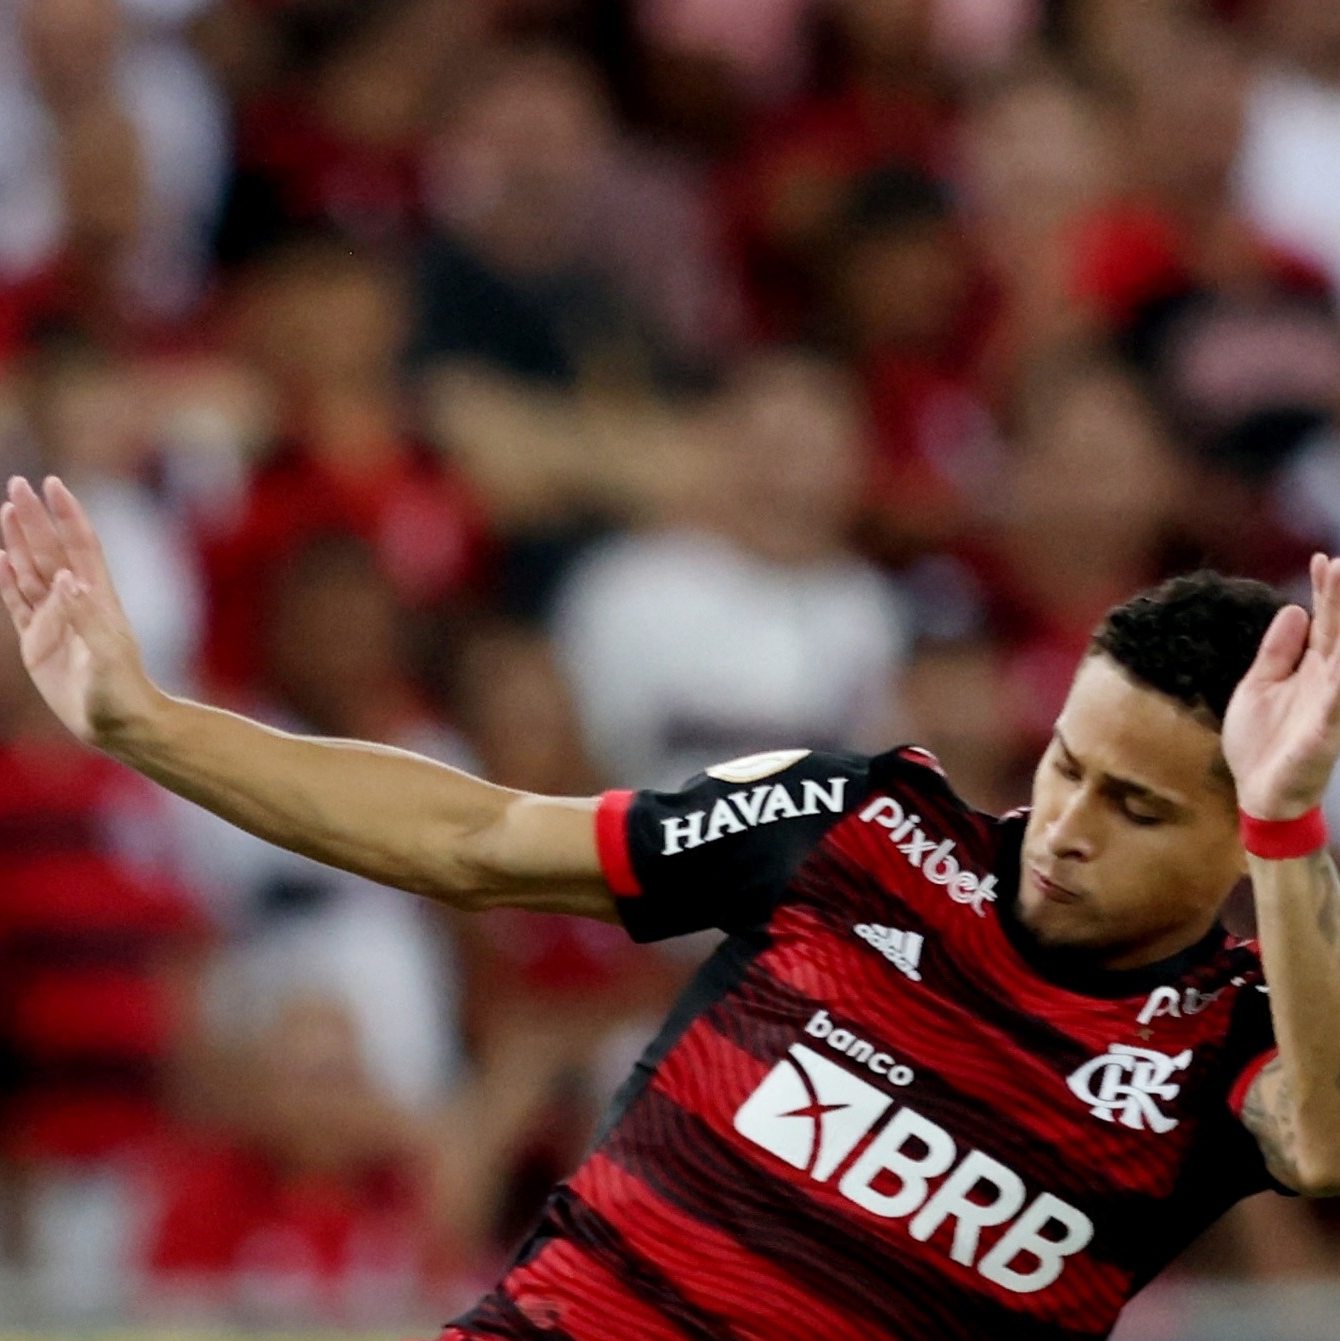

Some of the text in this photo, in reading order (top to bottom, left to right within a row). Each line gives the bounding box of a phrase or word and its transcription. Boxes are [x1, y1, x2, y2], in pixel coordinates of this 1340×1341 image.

[660, 776, 849, 856] HAVAN
[805, 1009, 915, 1087] banco
[837, 1106, 1096, 1295] BRB
